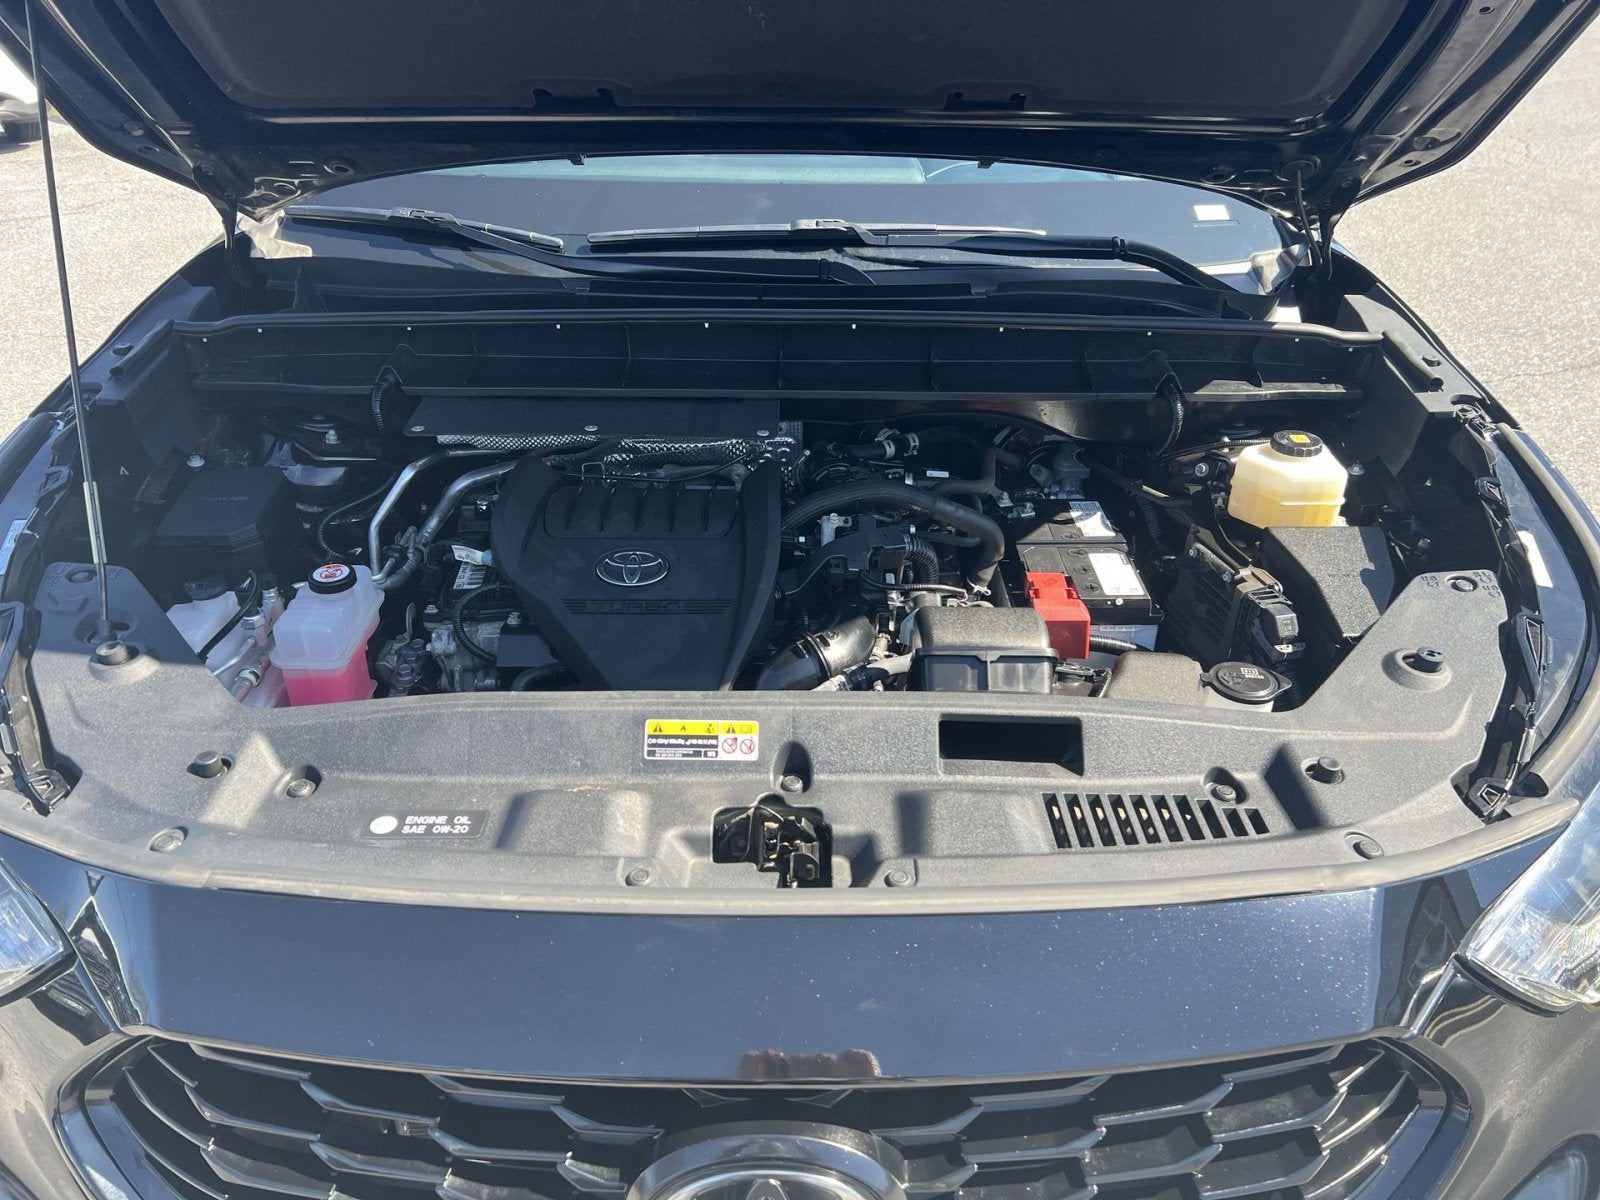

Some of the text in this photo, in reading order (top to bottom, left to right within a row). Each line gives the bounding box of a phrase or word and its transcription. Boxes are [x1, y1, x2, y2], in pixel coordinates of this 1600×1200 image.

[405, 816, 471, 824] ENGINE OIL
[401, 825, 469, 834] SAE 0W-20
